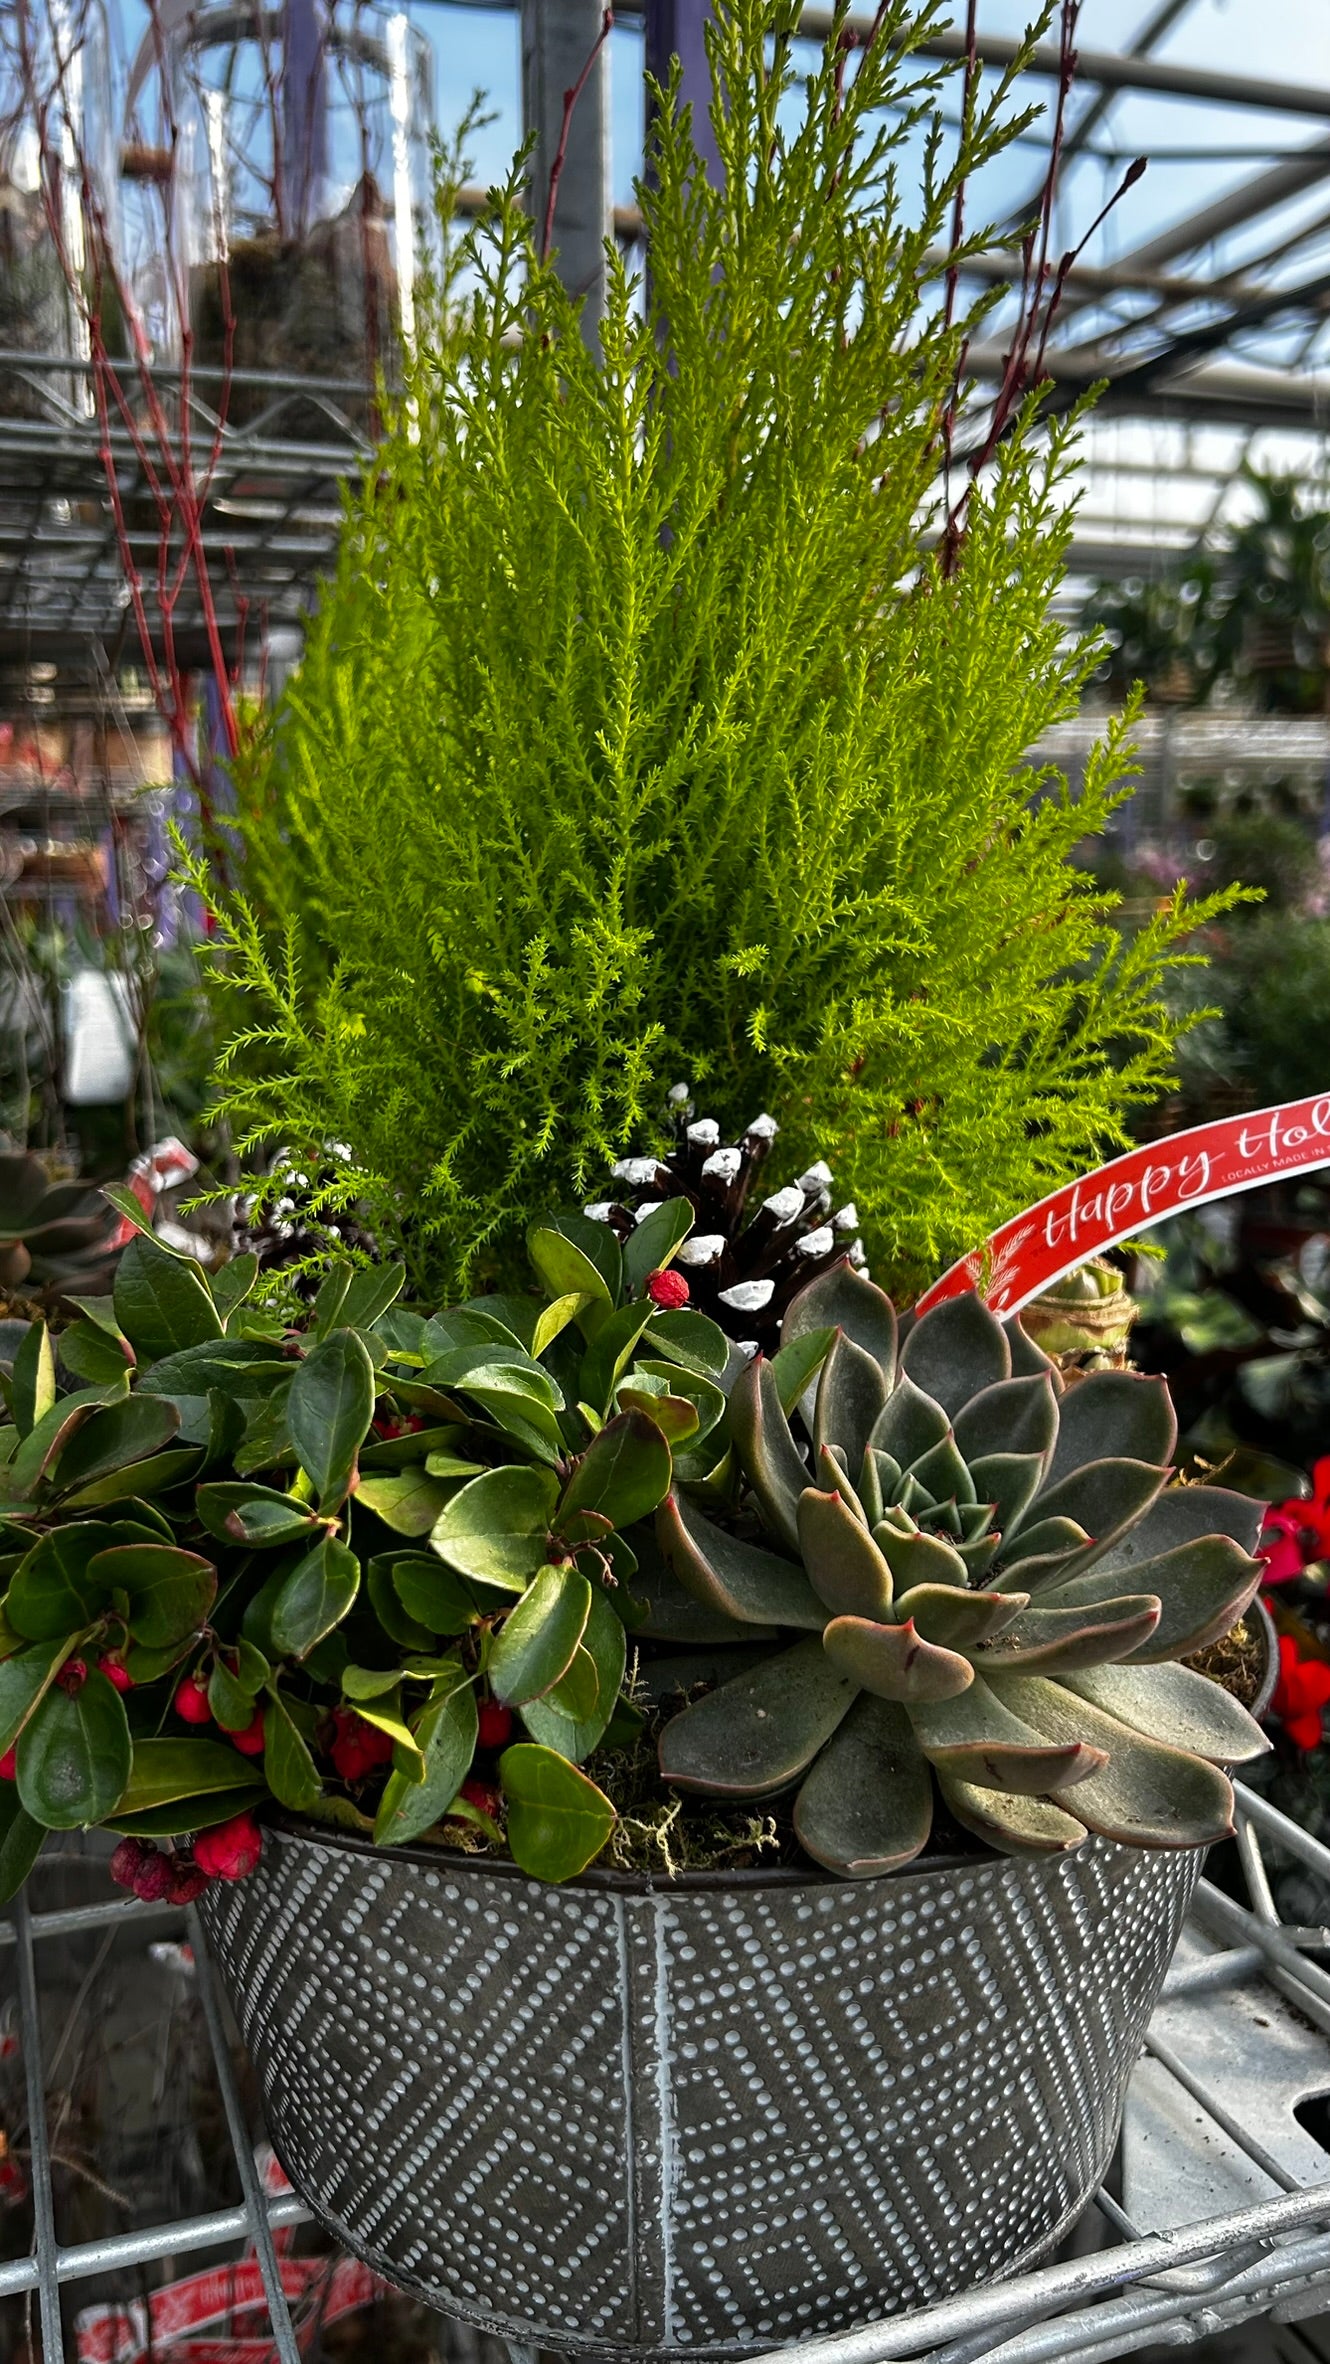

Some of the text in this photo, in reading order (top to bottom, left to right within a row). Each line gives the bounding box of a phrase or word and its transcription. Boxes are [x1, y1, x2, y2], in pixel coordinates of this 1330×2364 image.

[1221, 1162, 1269, 1183] LOCALLY
[1272, 1152, 1309, 1168] MADE
[1311, 1147, 1325, 1157] IN
[1042, 1150, 1225, 1248] Happy
